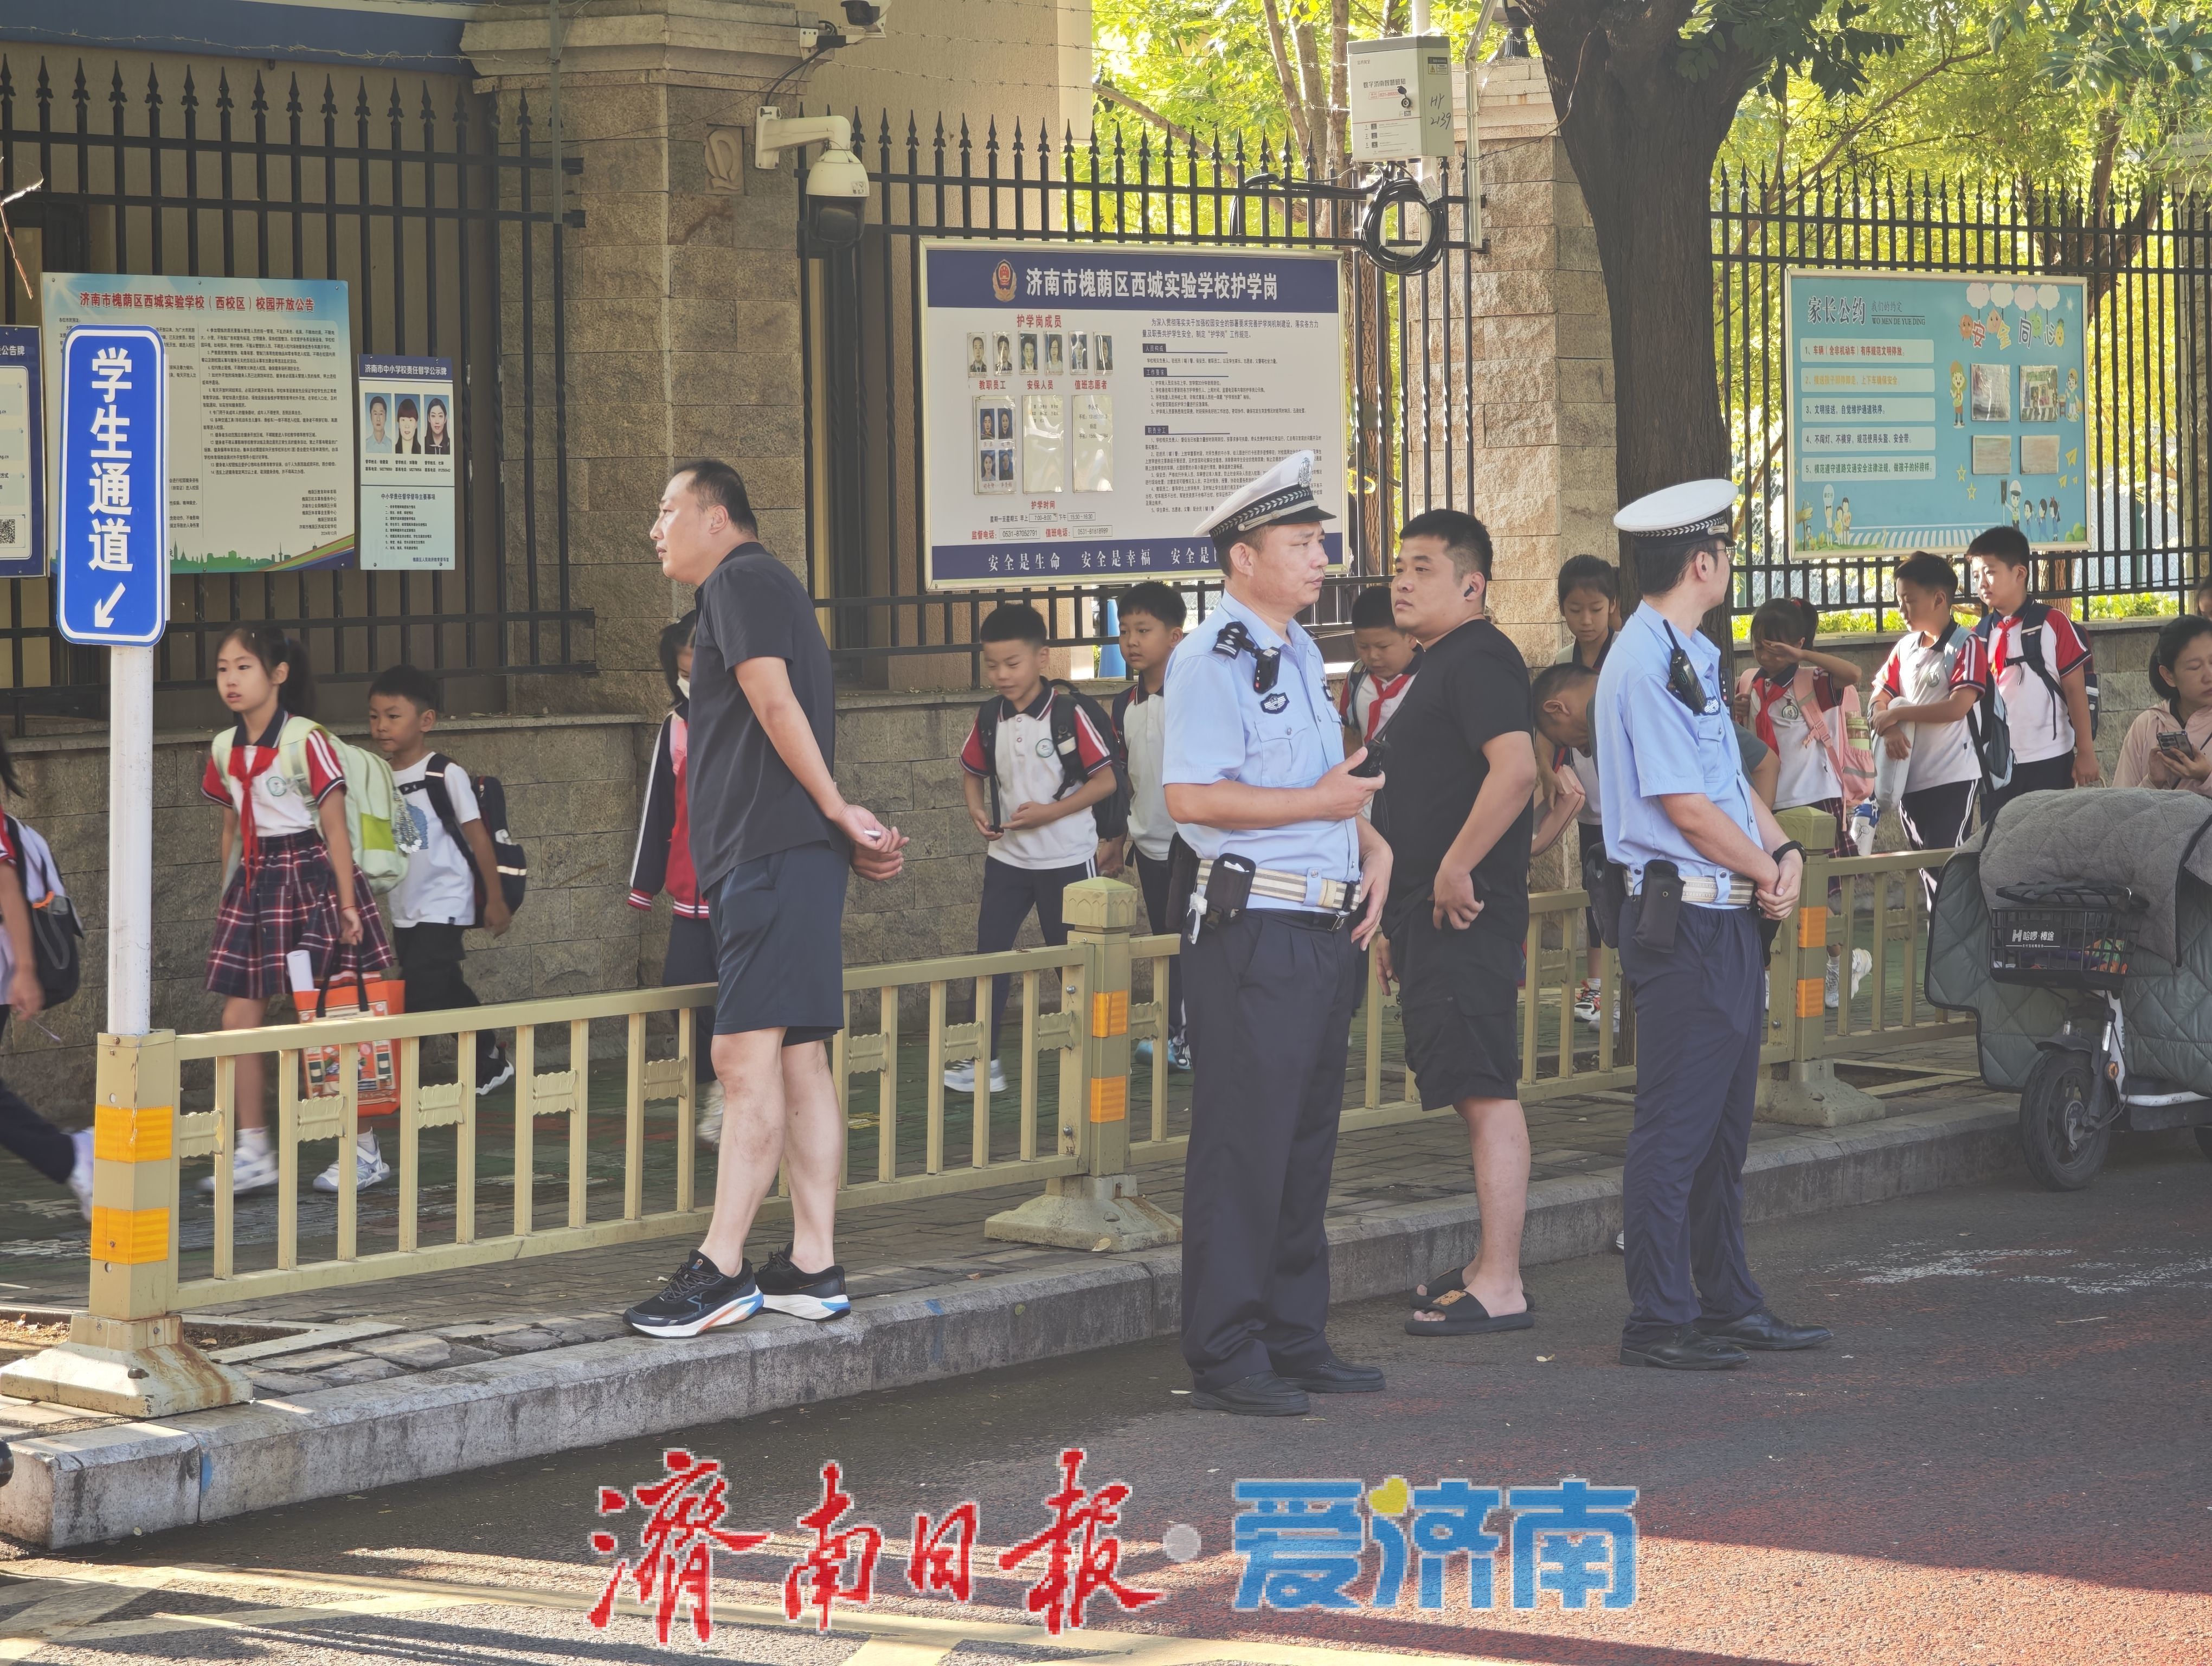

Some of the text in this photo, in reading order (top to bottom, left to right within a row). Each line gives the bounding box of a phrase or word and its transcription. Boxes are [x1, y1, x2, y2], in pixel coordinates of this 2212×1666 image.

[1430, 93, 1445, 110] HY
[1430, 112, 1451, 130] 2139
[1025, 267, 1278, 300] 济南市槐荫区西城实验学校护学岗
[79, 291, 316, 312] 济南市槐荫区西城实验学校（西校区）校园开放公告
[1807, 295, 1866, 325] 家长公约
[1017, 314, 1063, 328] 护学岗成员
[0, 344, 25, 356] 公告牌
[364, 364, 447, 375] 济南市中小学校责任督学公示牌
[979, 379, 1006, 390] 教职员工
[1026, 379, 1054, 390] 安保人员
[1075, 379, 1107, 390] 值班志愿者
[88, 347, 133, 572] 学生通道
[1031, 501, 1056, 510] 护学时间
[990, 515, 1018, 523] 星期一至星期五
[972, 529, 1038, 540] 监督电话： 0531-87052791
[1045, 528, 1071, 537] 值班电话：
[988, 546, 1217, 572] 安全是生命 安全是幸福 安全是
